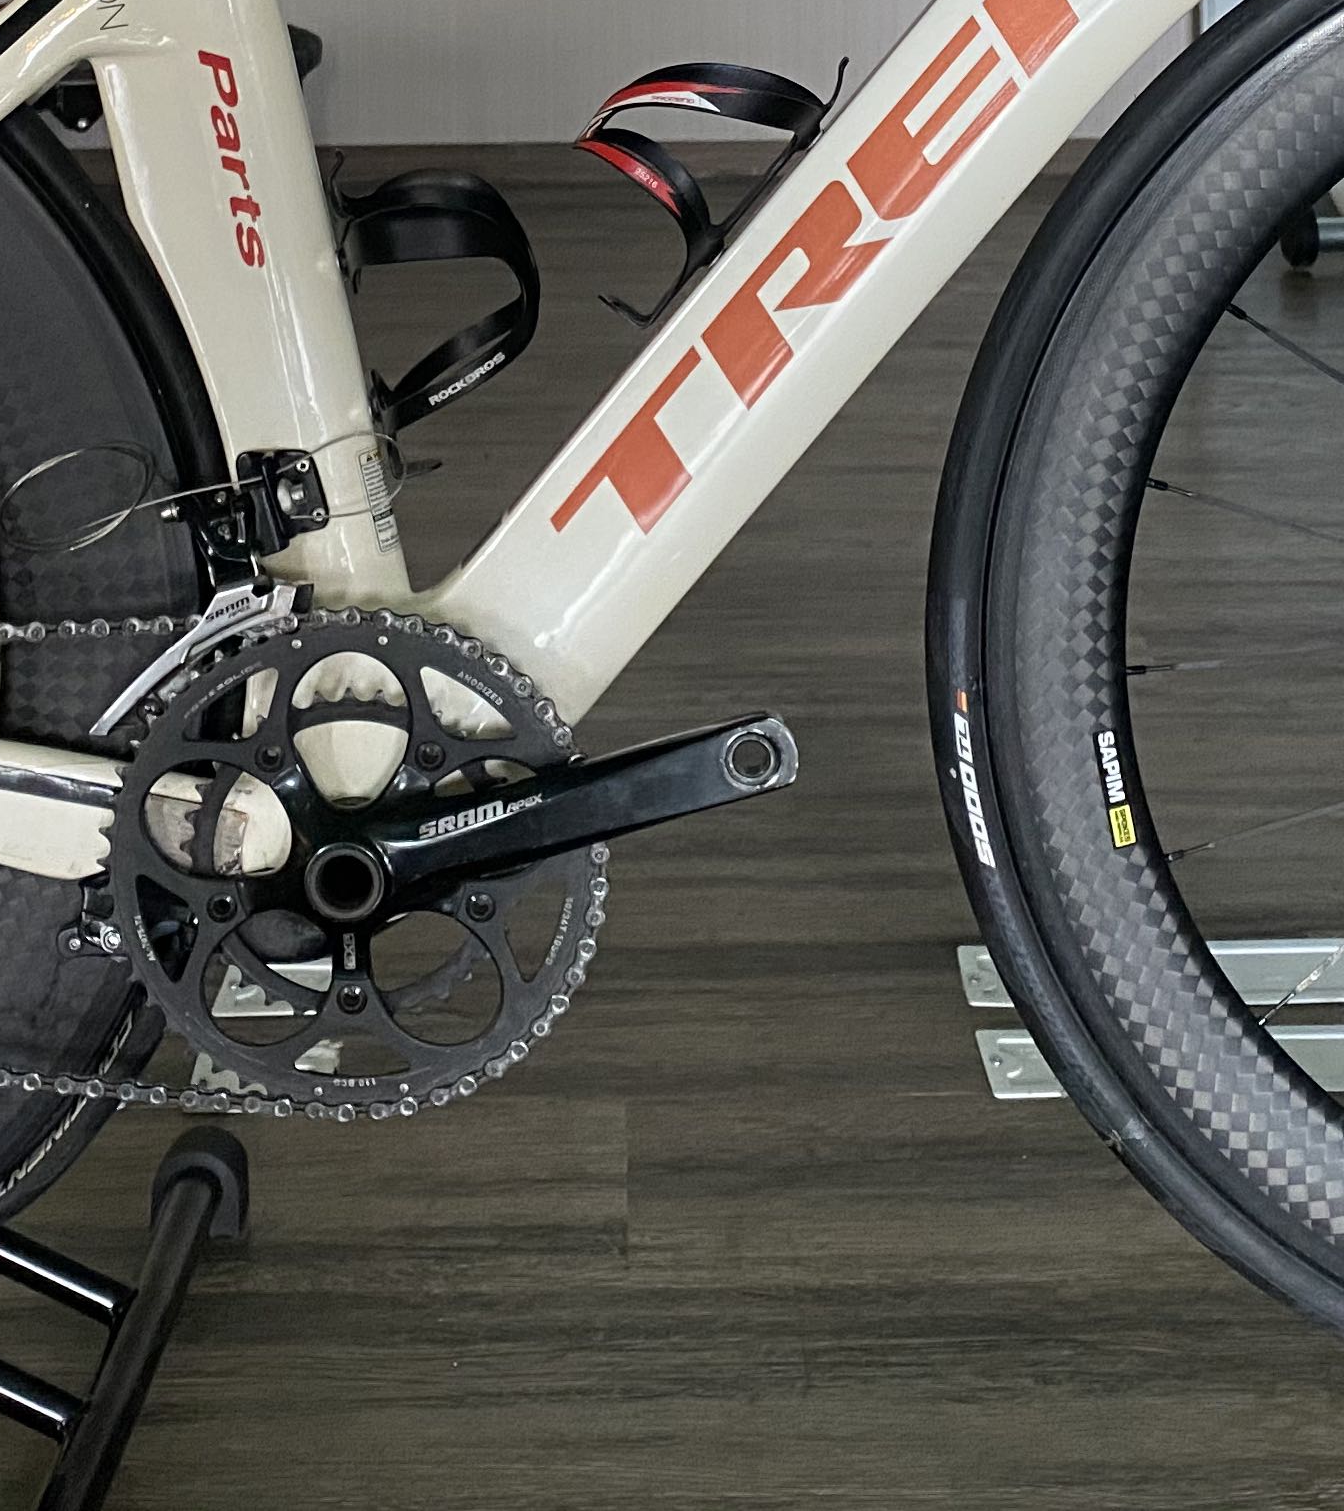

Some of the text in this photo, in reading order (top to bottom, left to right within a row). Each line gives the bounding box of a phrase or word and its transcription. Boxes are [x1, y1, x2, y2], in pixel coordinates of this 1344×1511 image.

[197, 50, 265, 268] Parts
[205, 596, 251, 621] SRAM
[456, 670, 504, 707] ANODIZED
[1097, 730, 1126, 804] SAPIM
[419, 799, 505, 840] SRAM
[958, 760, 997, 869] 5000
